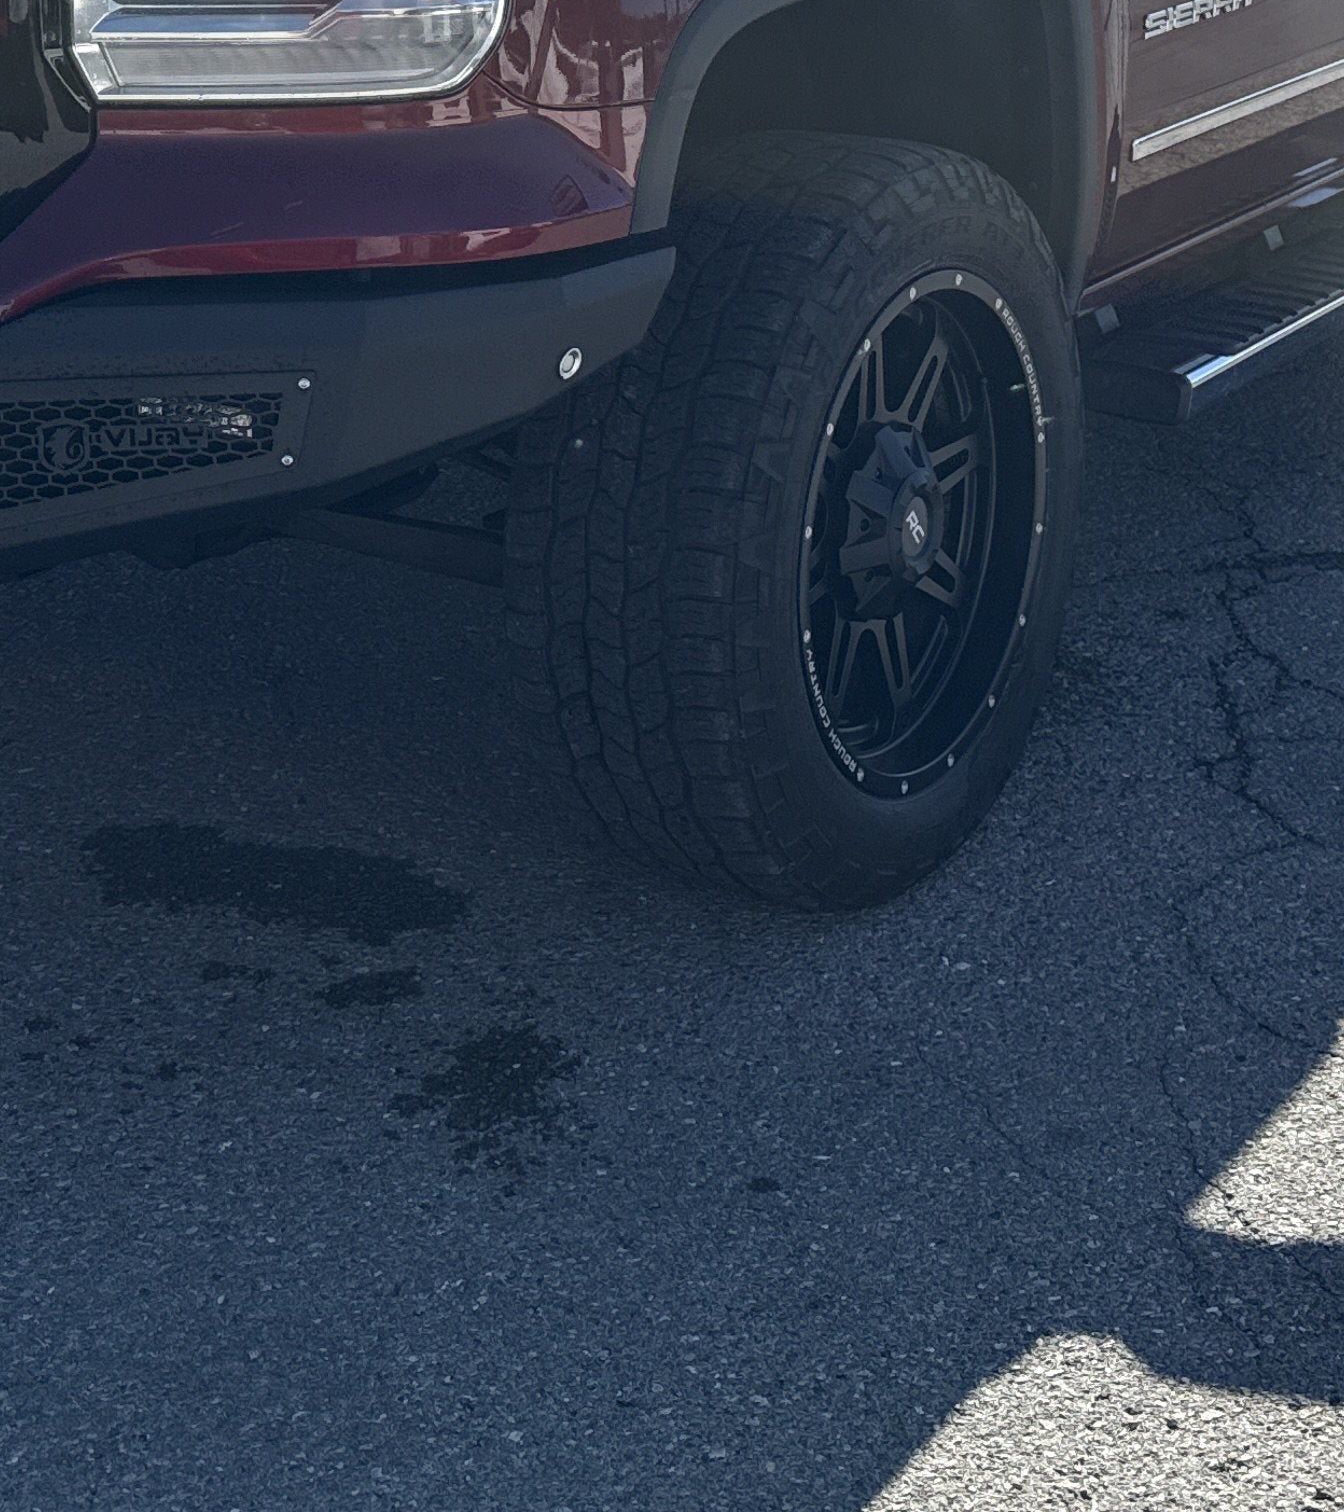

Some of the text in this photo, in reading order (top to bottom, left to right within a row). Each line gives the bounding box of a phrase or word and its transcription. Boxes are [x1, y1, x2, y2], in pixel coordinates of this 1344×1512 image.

[1001, 307, 1047, 427] ROUGH COUNTRY
[905, 510, 925, 544] RC
[806, 648, 858, 773] ROUGH COUNTRY
